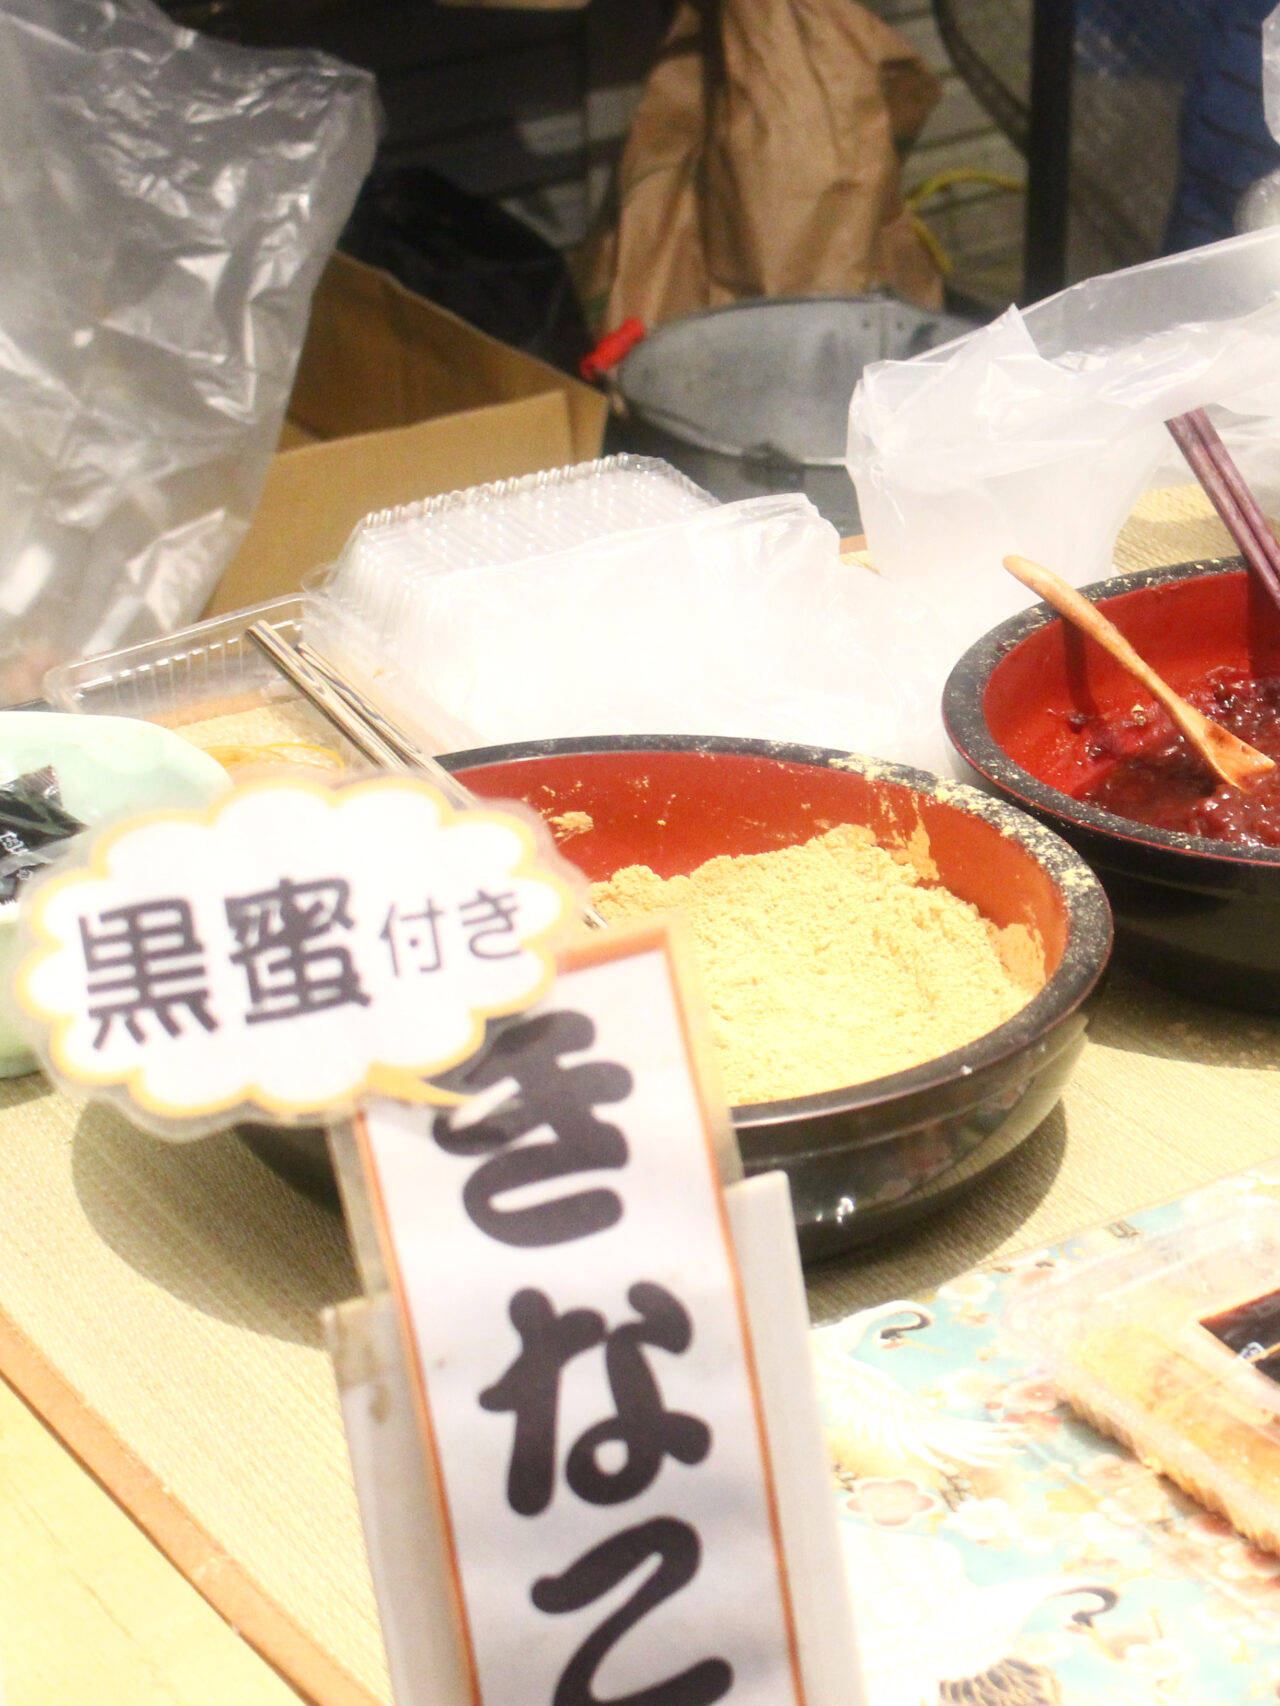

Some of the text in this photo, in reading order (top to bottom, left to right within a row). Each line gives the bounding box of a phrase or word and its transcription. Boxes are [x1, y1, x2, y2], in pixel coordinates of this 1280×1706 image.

[78, 878, 523, 1050] 黒蜜付き
[425, 1009, 735, 1706] きなこ
